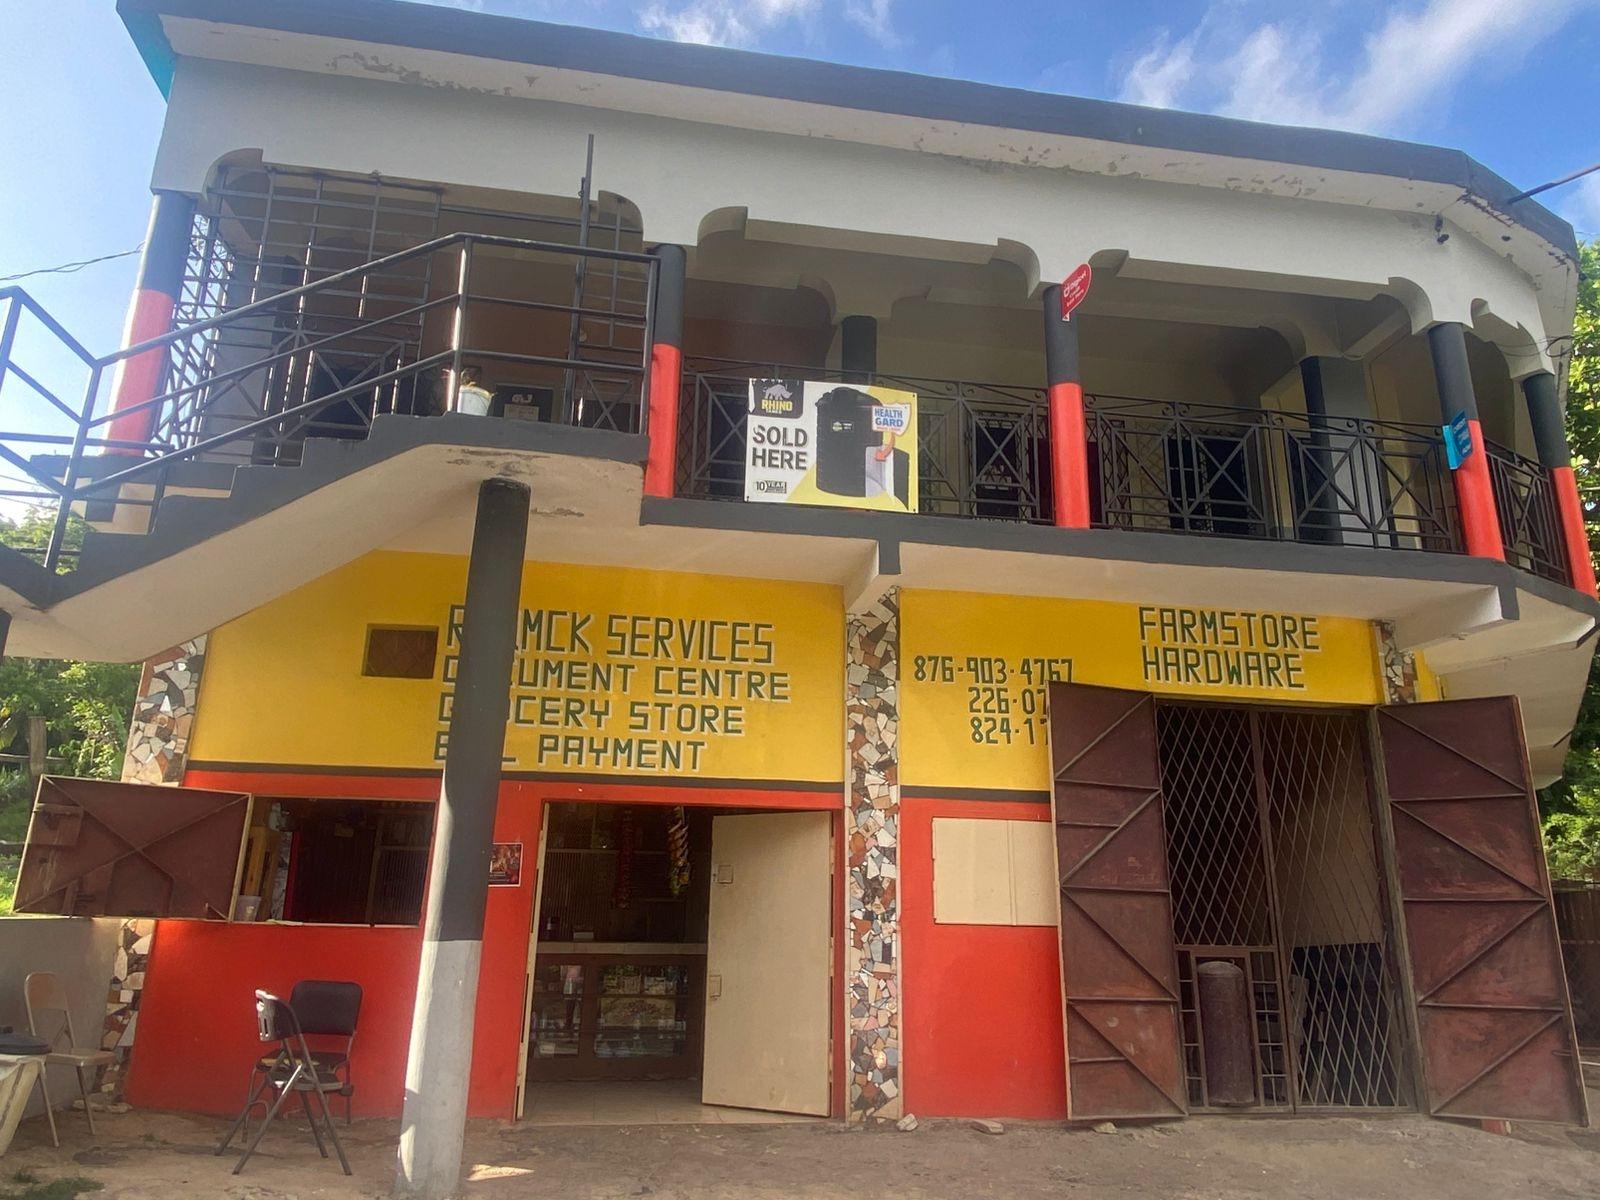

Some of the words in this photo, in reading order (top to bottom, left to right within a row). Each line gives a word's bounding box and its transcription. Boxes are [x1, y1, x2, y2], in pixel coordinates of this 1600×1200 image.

[761, 399, 793, 412] RHINO
[874, 407, 903, 419] HEALTH
[875, 417, 904, 428] GARD
[752, 424, 808, 448] SOLD
[751, 447, 807, 471] HERE
[606, 613, 774, 664] SERVICES
[1138, 606, 1320, 650] FARMSTORE
[653, 665, 791, 701] CENTRE
[1142, 645, 1305, 689] HARDWARE
[628, 700, 745, 735] STORE
[537, 733, 706, 770] PAYMENT
